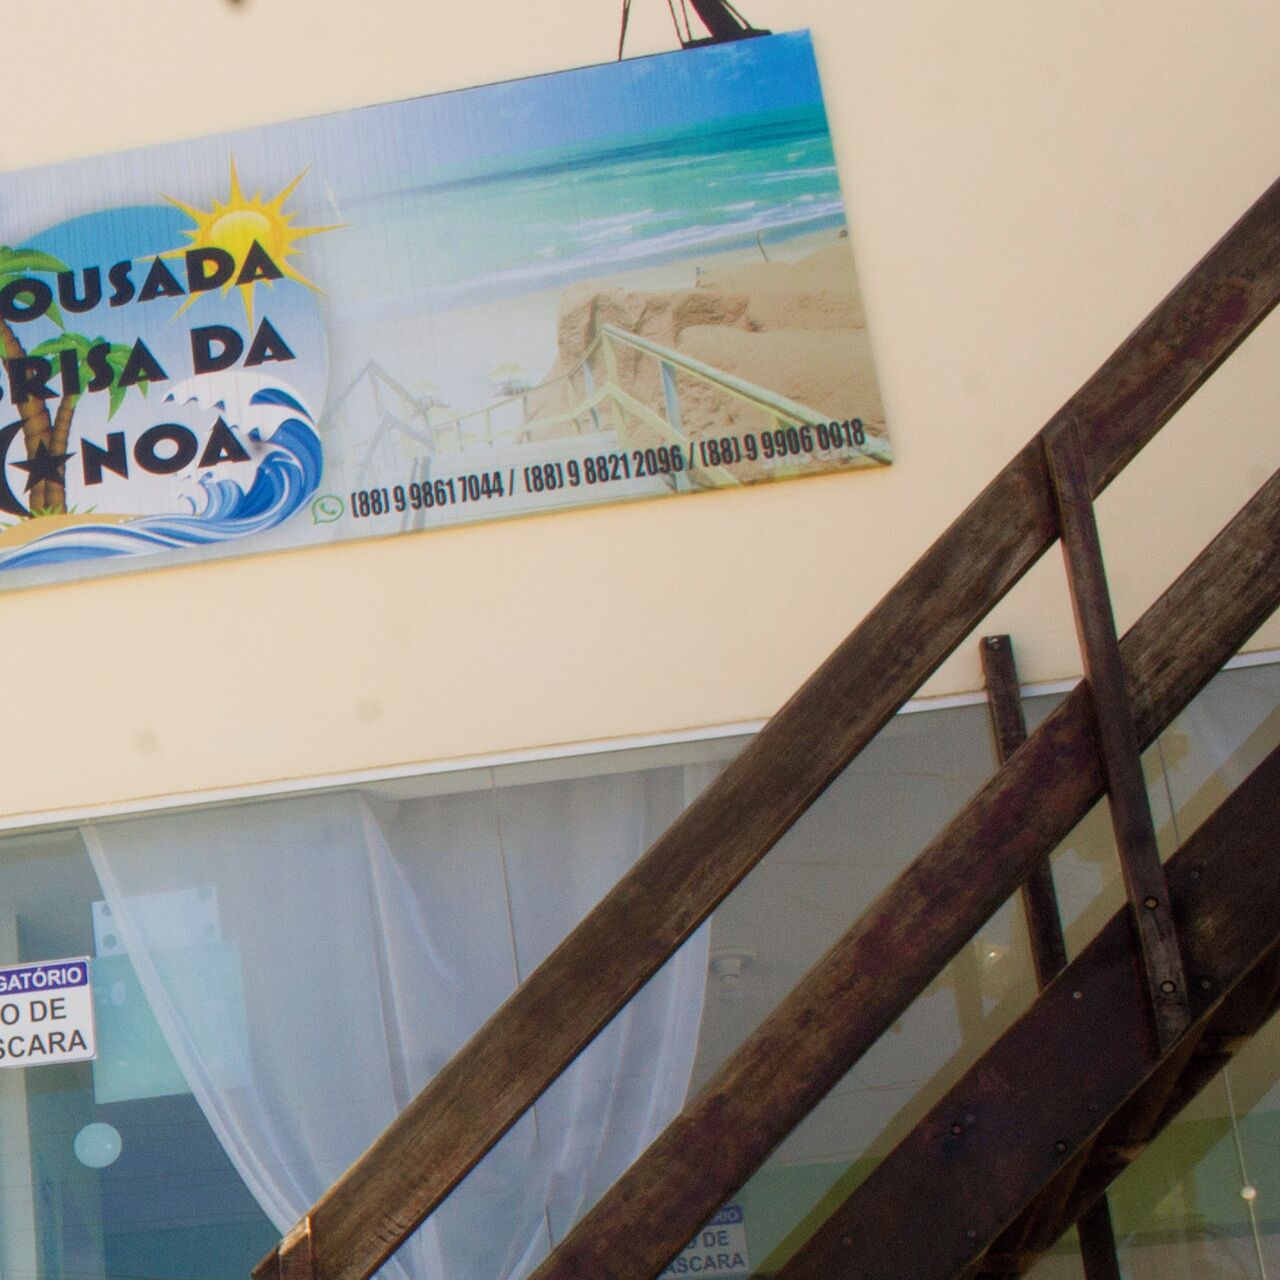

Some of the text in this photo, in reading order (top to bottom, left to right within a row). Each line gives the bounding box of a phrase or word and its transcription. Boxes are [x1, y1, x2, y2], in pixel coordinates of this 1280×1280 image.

[190, 315, 296, 375] DA
[350, 487, 390, 519] (88)
[393, 485, 406, 512] 9
[523, 462, 564, 494] (88)
[568, 459, 581, 487] 9
[632, 444, 684, 478] 2096
[699, 436, 741, 468] (88)
[743, 433, 758, 461] 9
[761, 423, 814, 459] 9906
[815, 417, 866, 451] 0018
[30, 997, 67, 1022] DE
[703, 1229, 729, 1248] DE
[662, 1252, 745, 1275] SCARA
